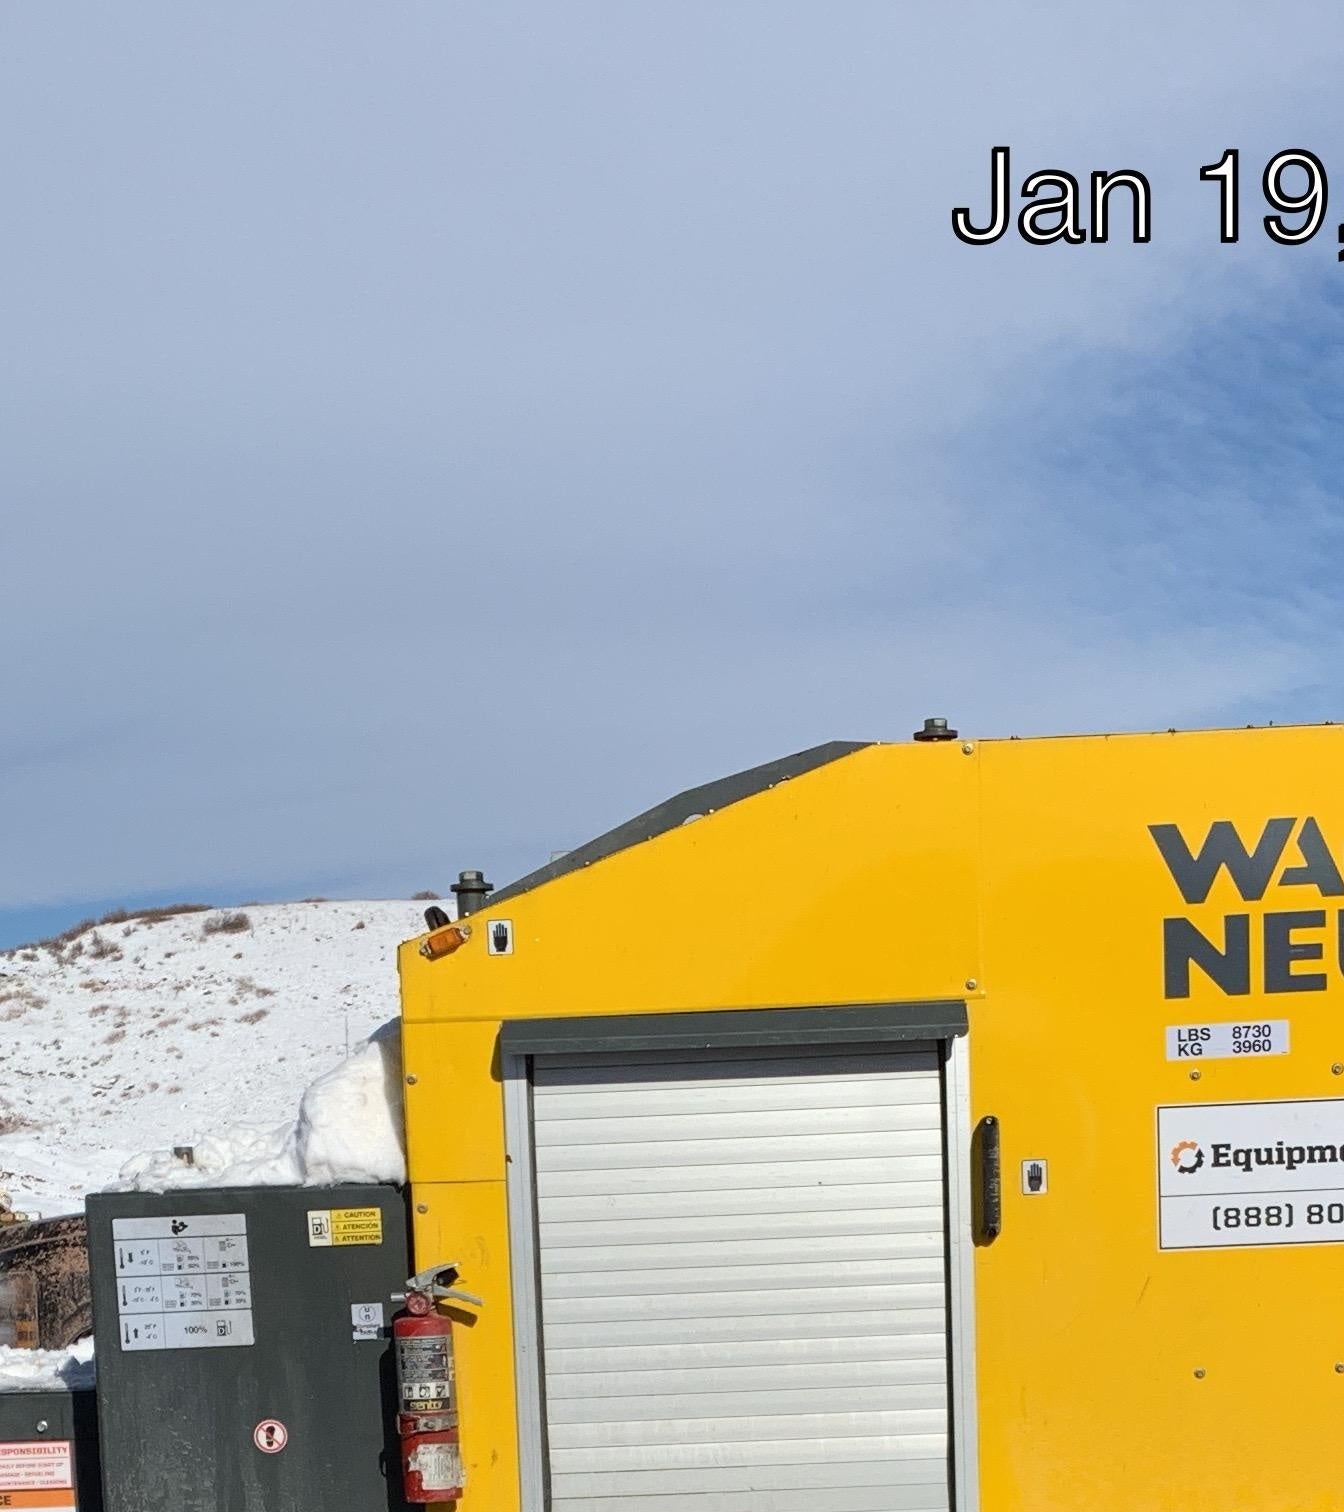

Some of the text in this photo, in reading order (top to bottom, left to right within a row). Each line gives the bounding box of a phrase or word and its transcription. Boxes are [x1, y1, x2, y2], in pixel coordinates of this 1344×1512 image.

[1177, 1024, 1272, 1042] LBS 8730
[1177, 1038, 1272, 1057] KG 3960
[343, 1210, 376, 1219] CAUTION
[1211, 1203, 1294, 1231] (888)
[184, 1325, 208, 1334] 100%
